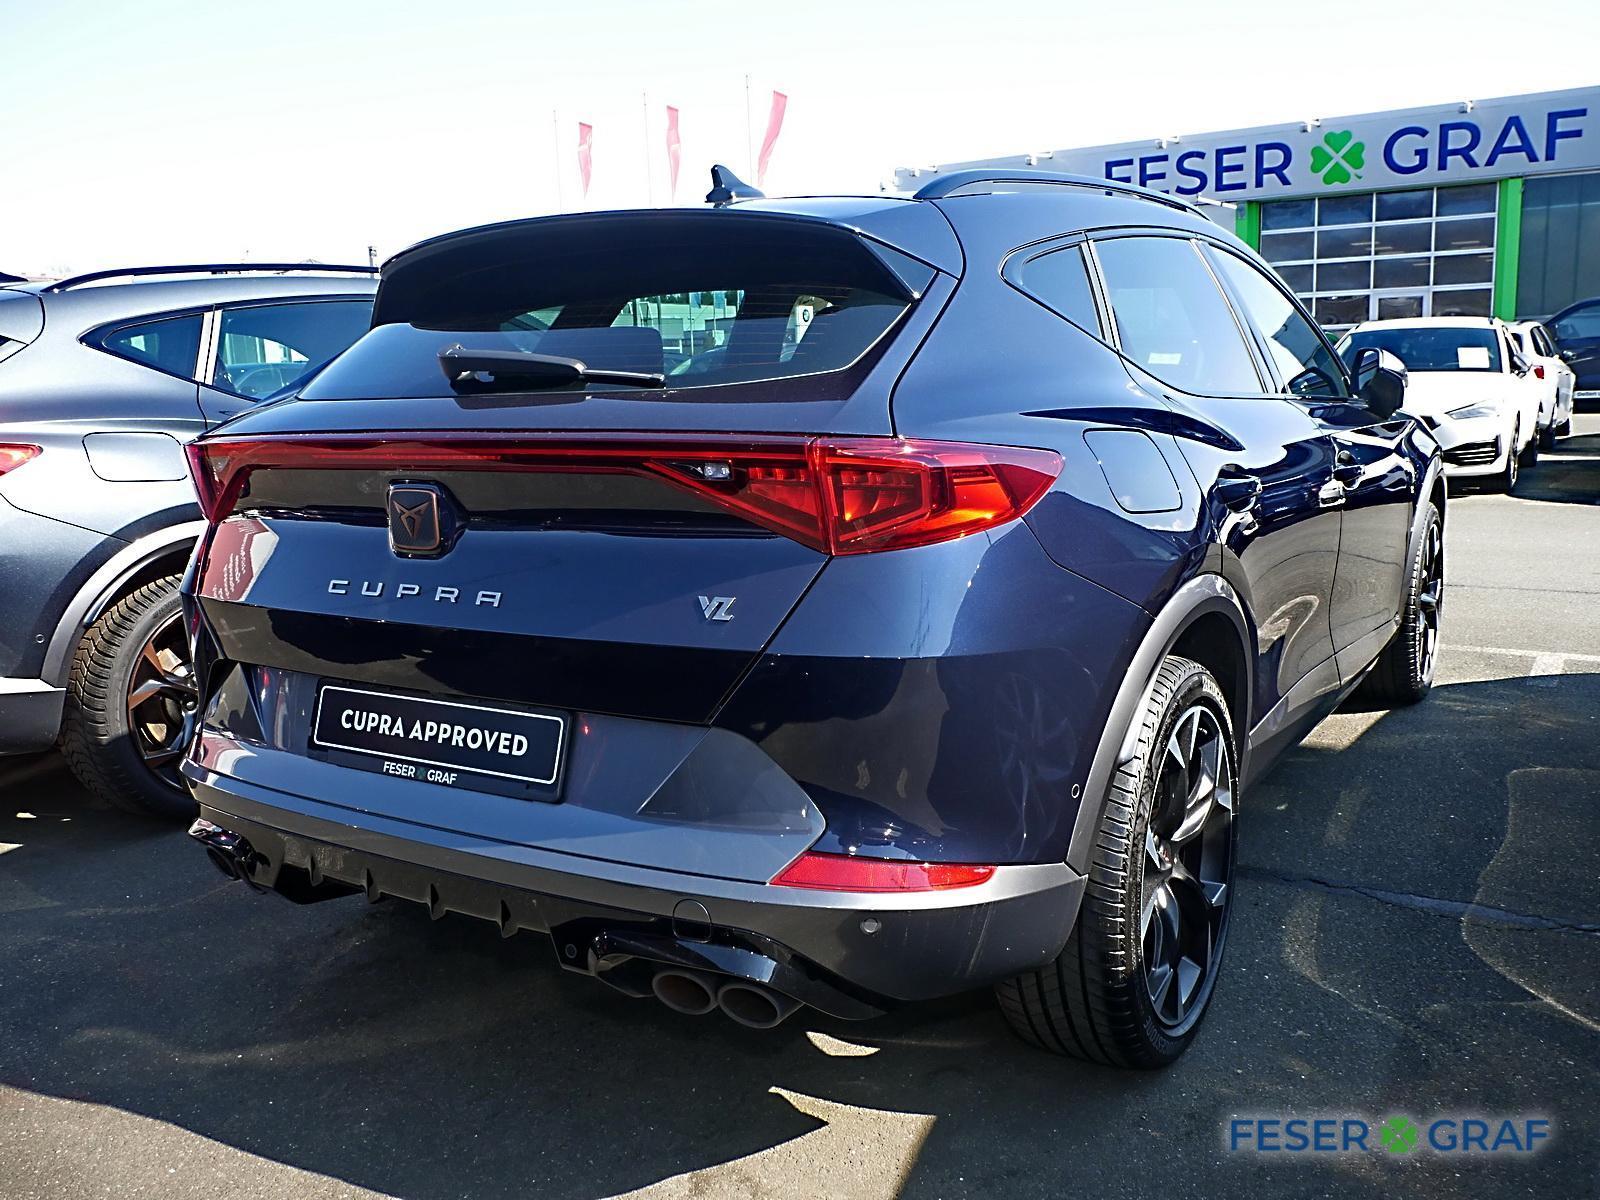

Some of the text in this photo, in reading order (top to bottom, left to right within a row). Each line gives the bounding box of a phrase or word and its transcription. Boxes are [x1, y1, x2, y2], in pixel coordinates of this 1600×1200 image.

[1104, 108, 1589, 197] FESER GRAF
[327, 579, 503, 608] CUPRA
[698, 595, 737, 622] VZ
[340, 708, 529, 757] CUPRA APPROVED
[382, 760, 458, 785] FESER GRAF
